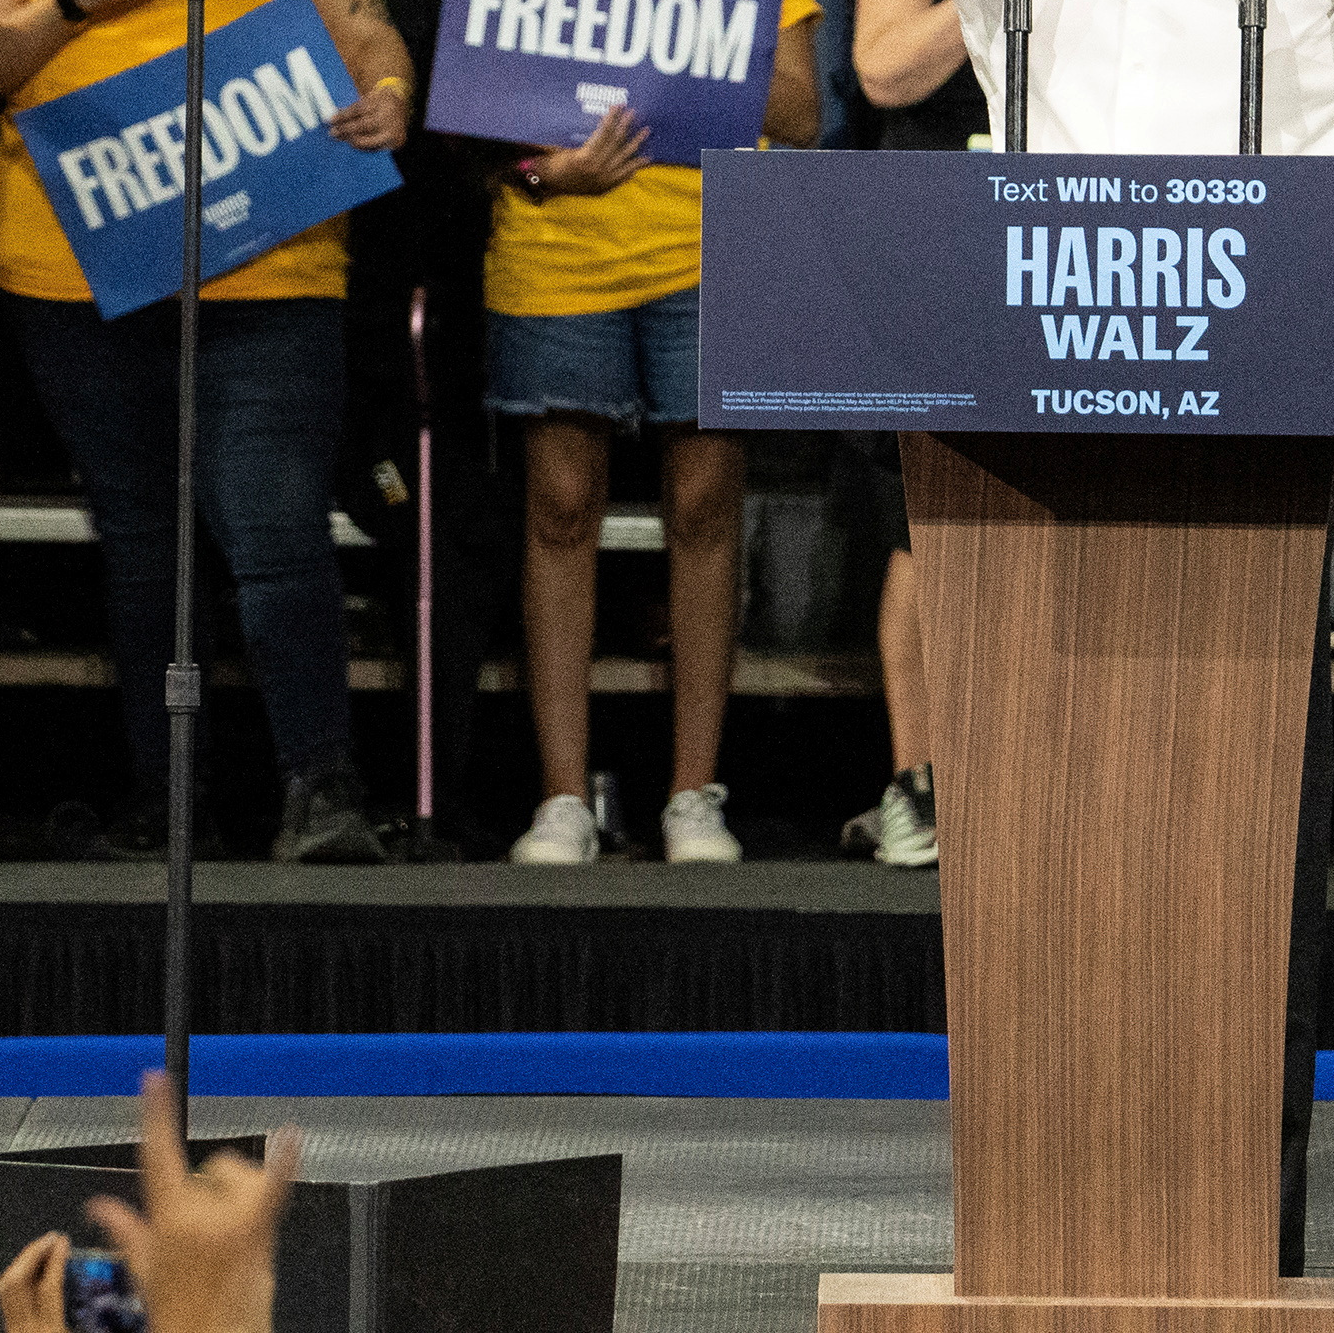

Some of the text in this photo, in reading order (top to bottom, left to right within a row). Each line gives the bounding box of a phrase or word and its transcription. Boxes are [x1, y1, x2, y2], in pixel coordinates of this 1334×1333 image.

[58, 46, 338, 230] FREEDOM
[988, 176, 1267, 204] Text WIN to 30330
[1005, 225, 1246, 309] HARRIS
[1041, 315, 1210, 361] WALZ
[1031, 389, 1220, 420] TUCSON, AZ
